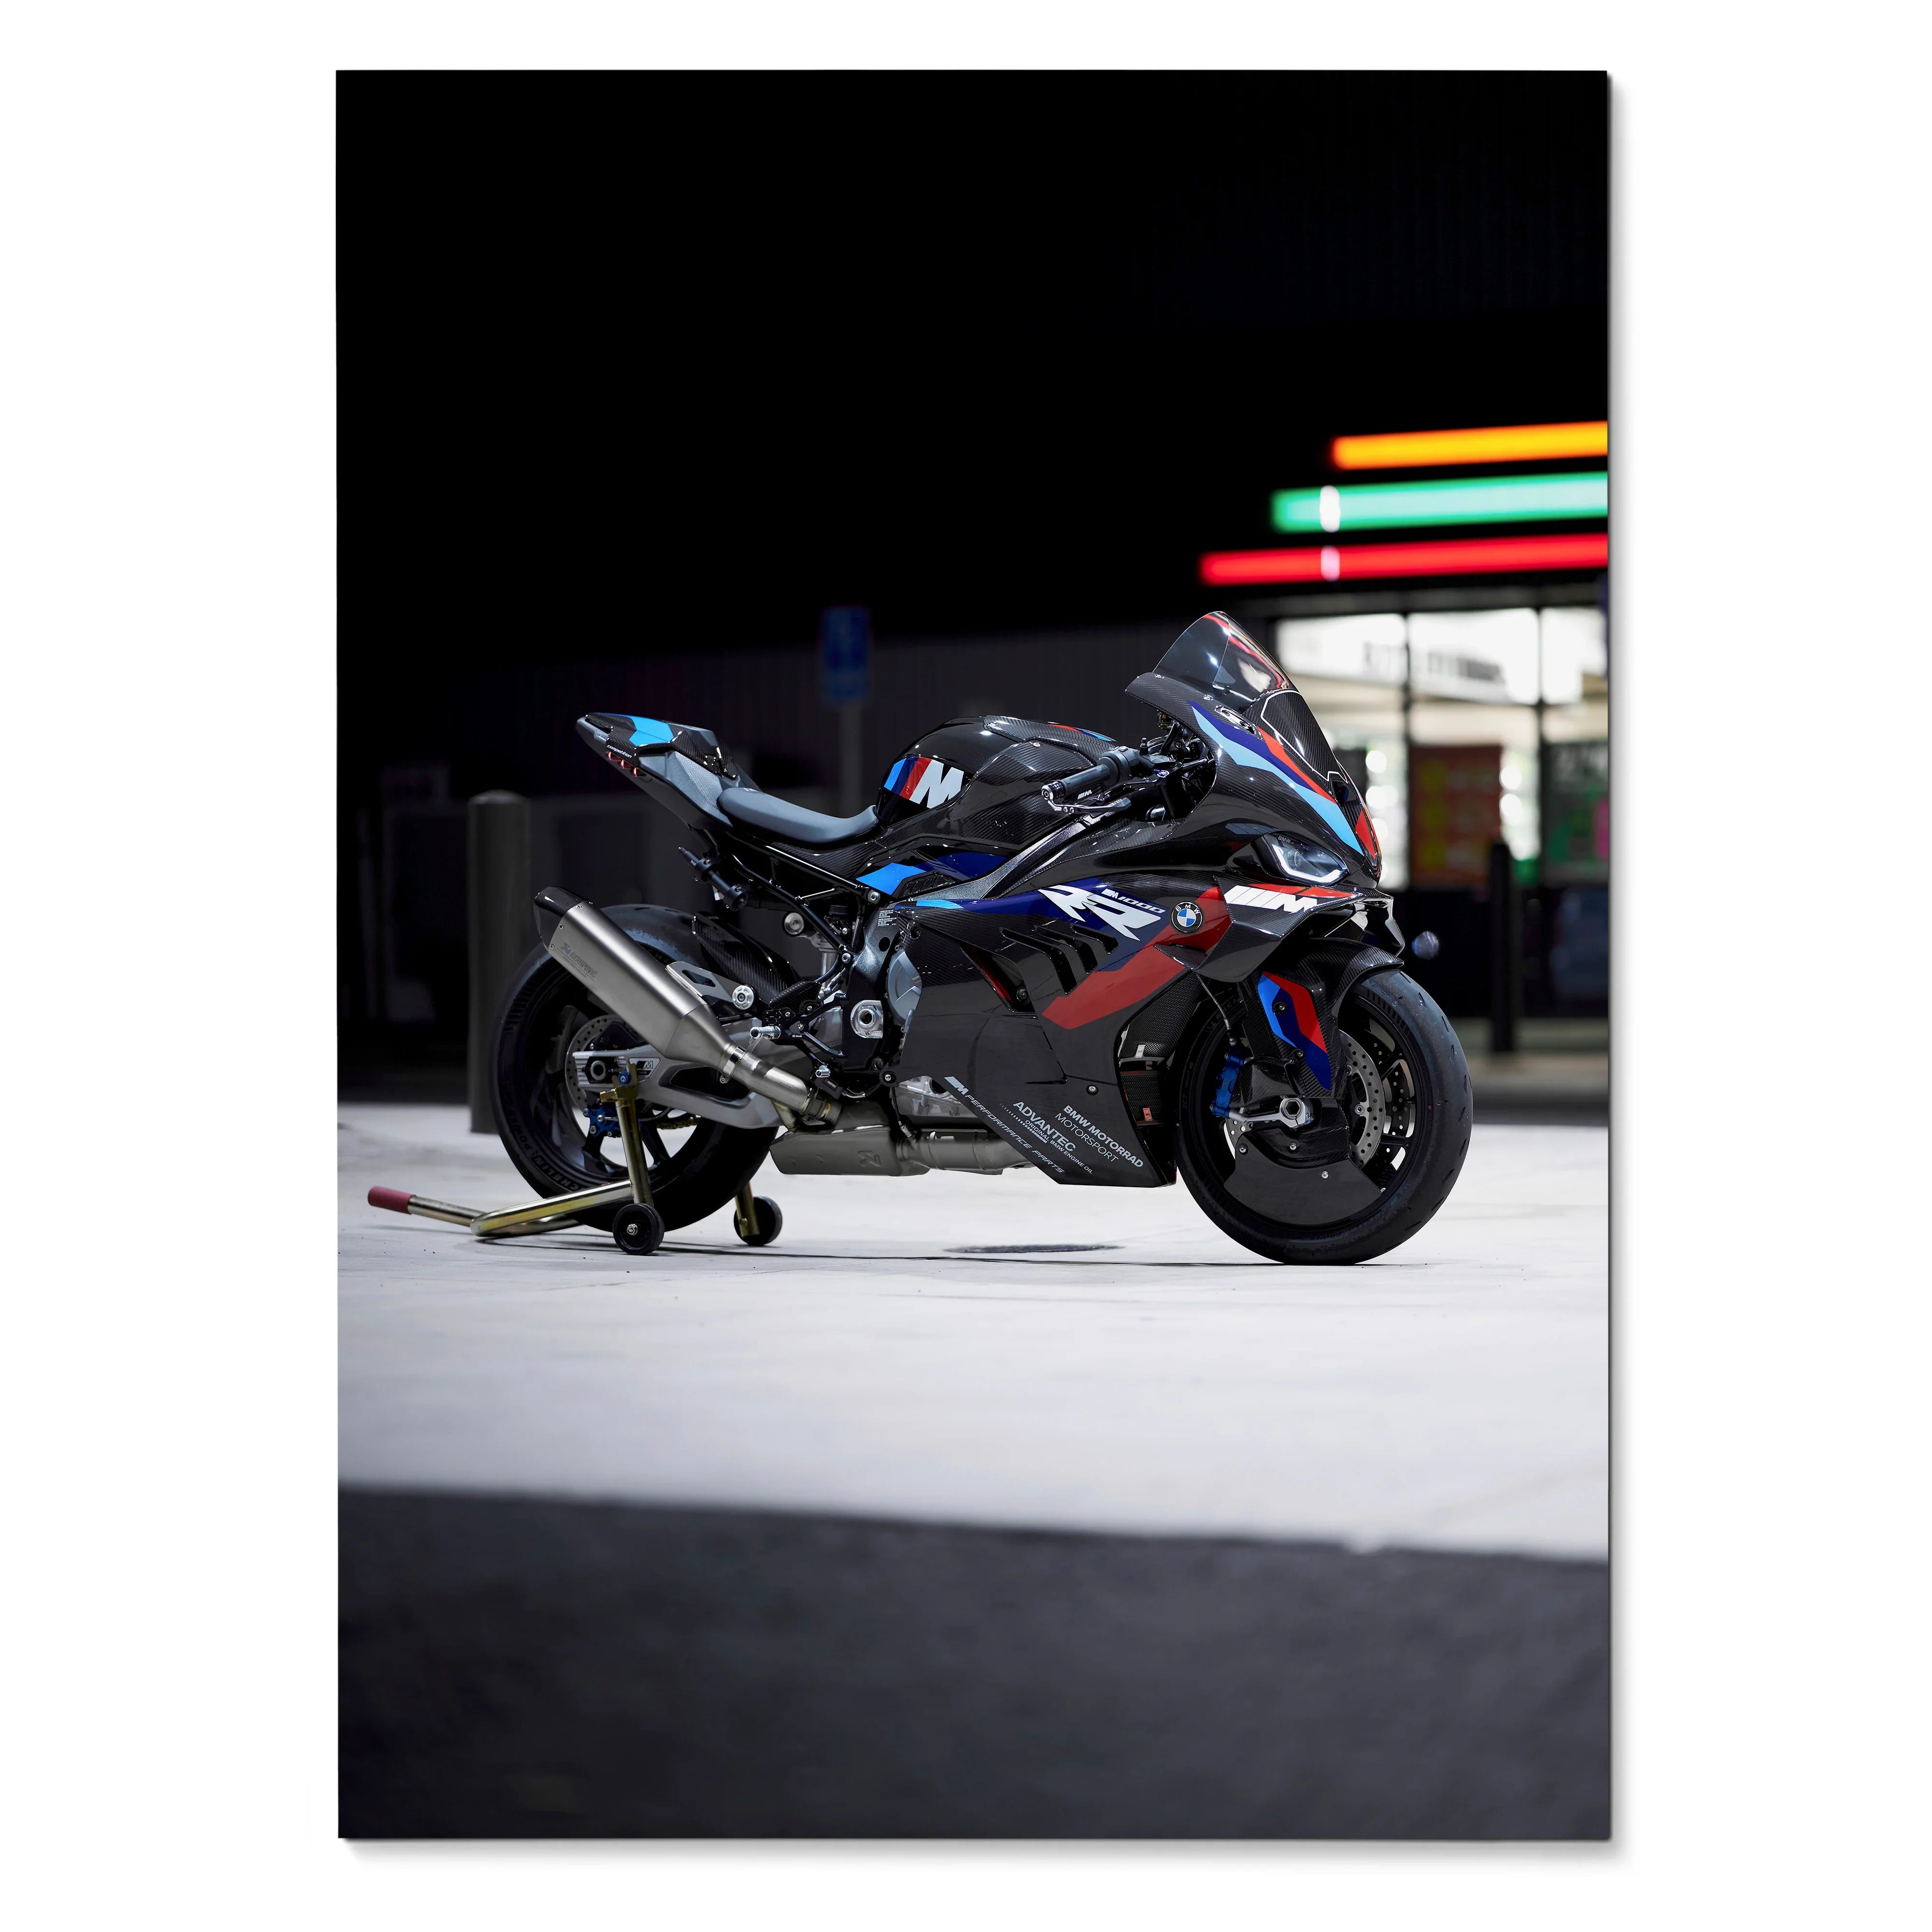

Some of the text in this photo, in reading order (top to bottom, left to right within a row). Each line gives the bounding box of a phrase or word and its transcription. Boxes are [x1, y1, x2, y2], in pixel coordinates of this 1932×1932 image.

[607, 745, 632, 758] competition
[909, 759, 964, 809] M
[1175, 904, 1200, 914] BMW
[965, 1094, 1033, 1149] PERFORMANCE
[1032, 1150, 1065, 1173] PARTS
[1013, 1101, 1076, 1151] ADVANTEC
[1025, 1120, 1094, 1174] ORIGINAL BMW ENGINE OIL
[1055, 1112, 1119, 1162] MOTORSPORT
[1063, 1105, 1144, 1167] BMW MOTORRAD
[533, 1154, 580, 1192] CHELIN
